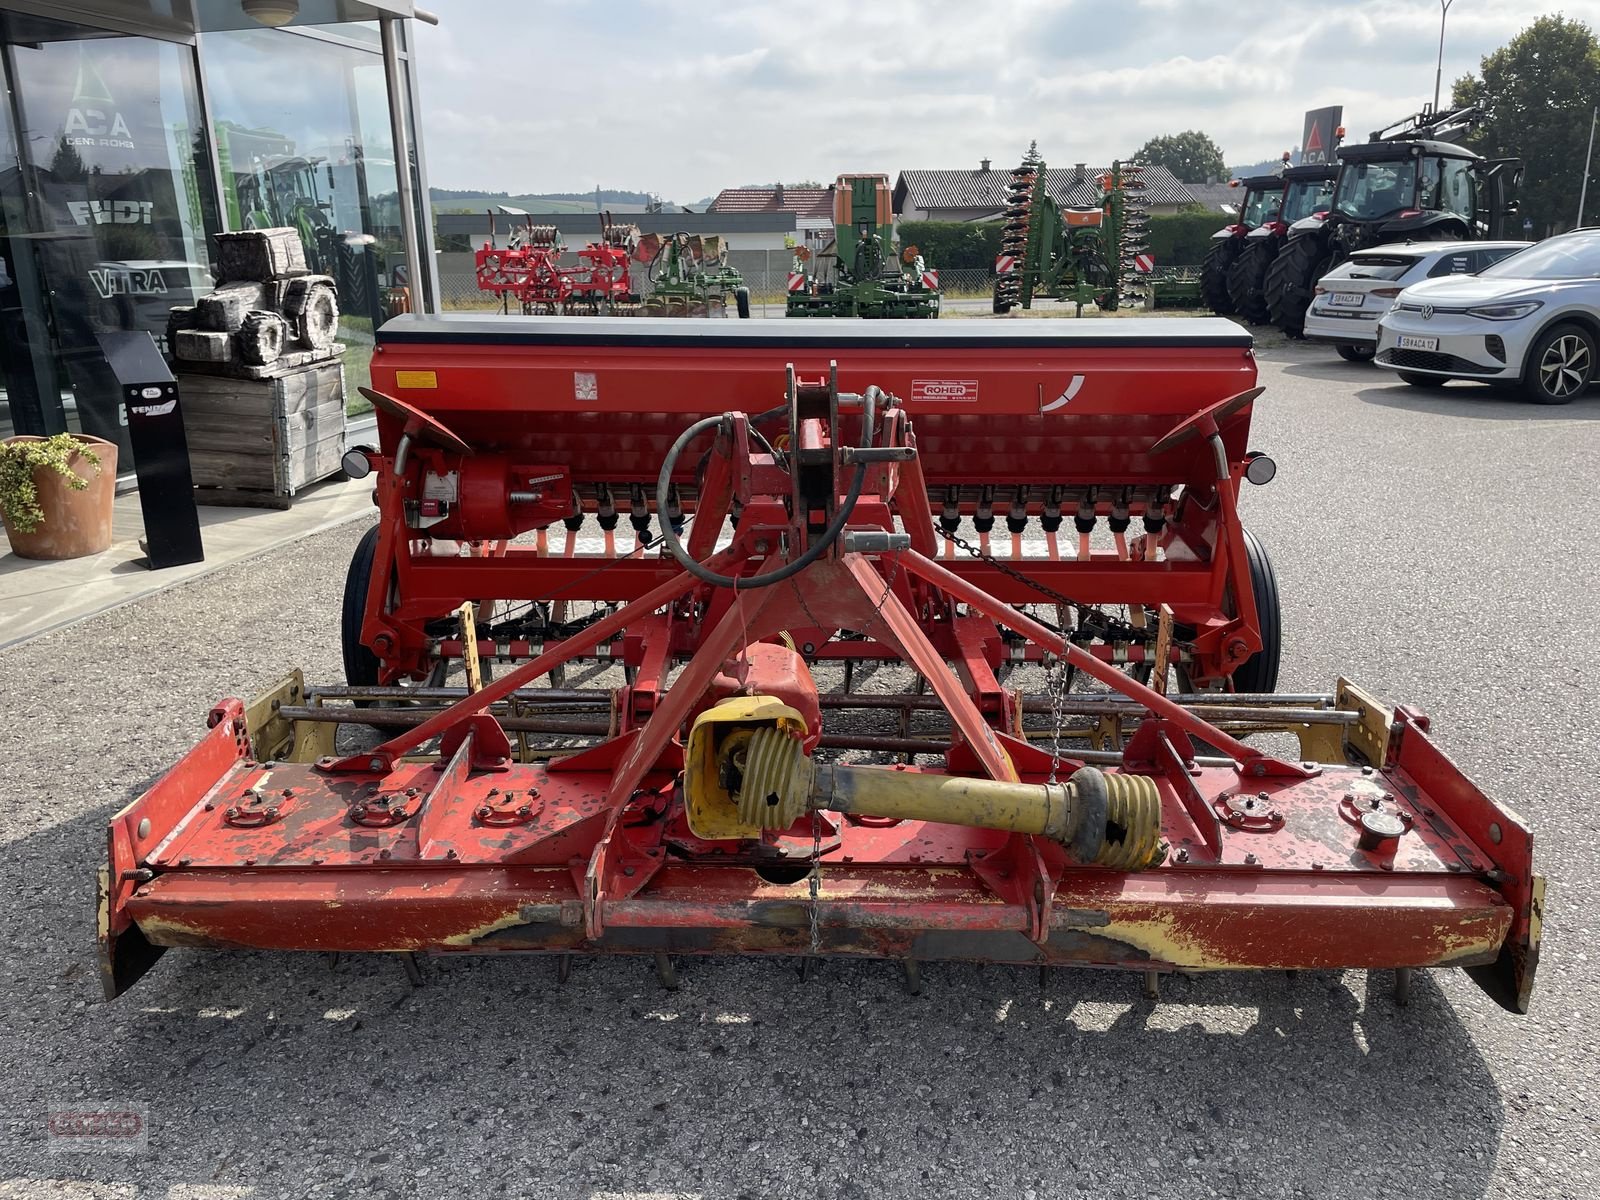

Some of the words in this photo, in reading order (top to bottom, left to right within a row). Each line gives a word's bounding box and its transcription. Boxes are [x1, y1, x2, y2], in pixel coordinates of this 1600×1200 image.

[1302, 151, 1326, 164] ACA
[1413, 339, 1425, 348] ACA
[926, 386, 964, 394] ROHER
[131, 403, 170, 416] FEND
